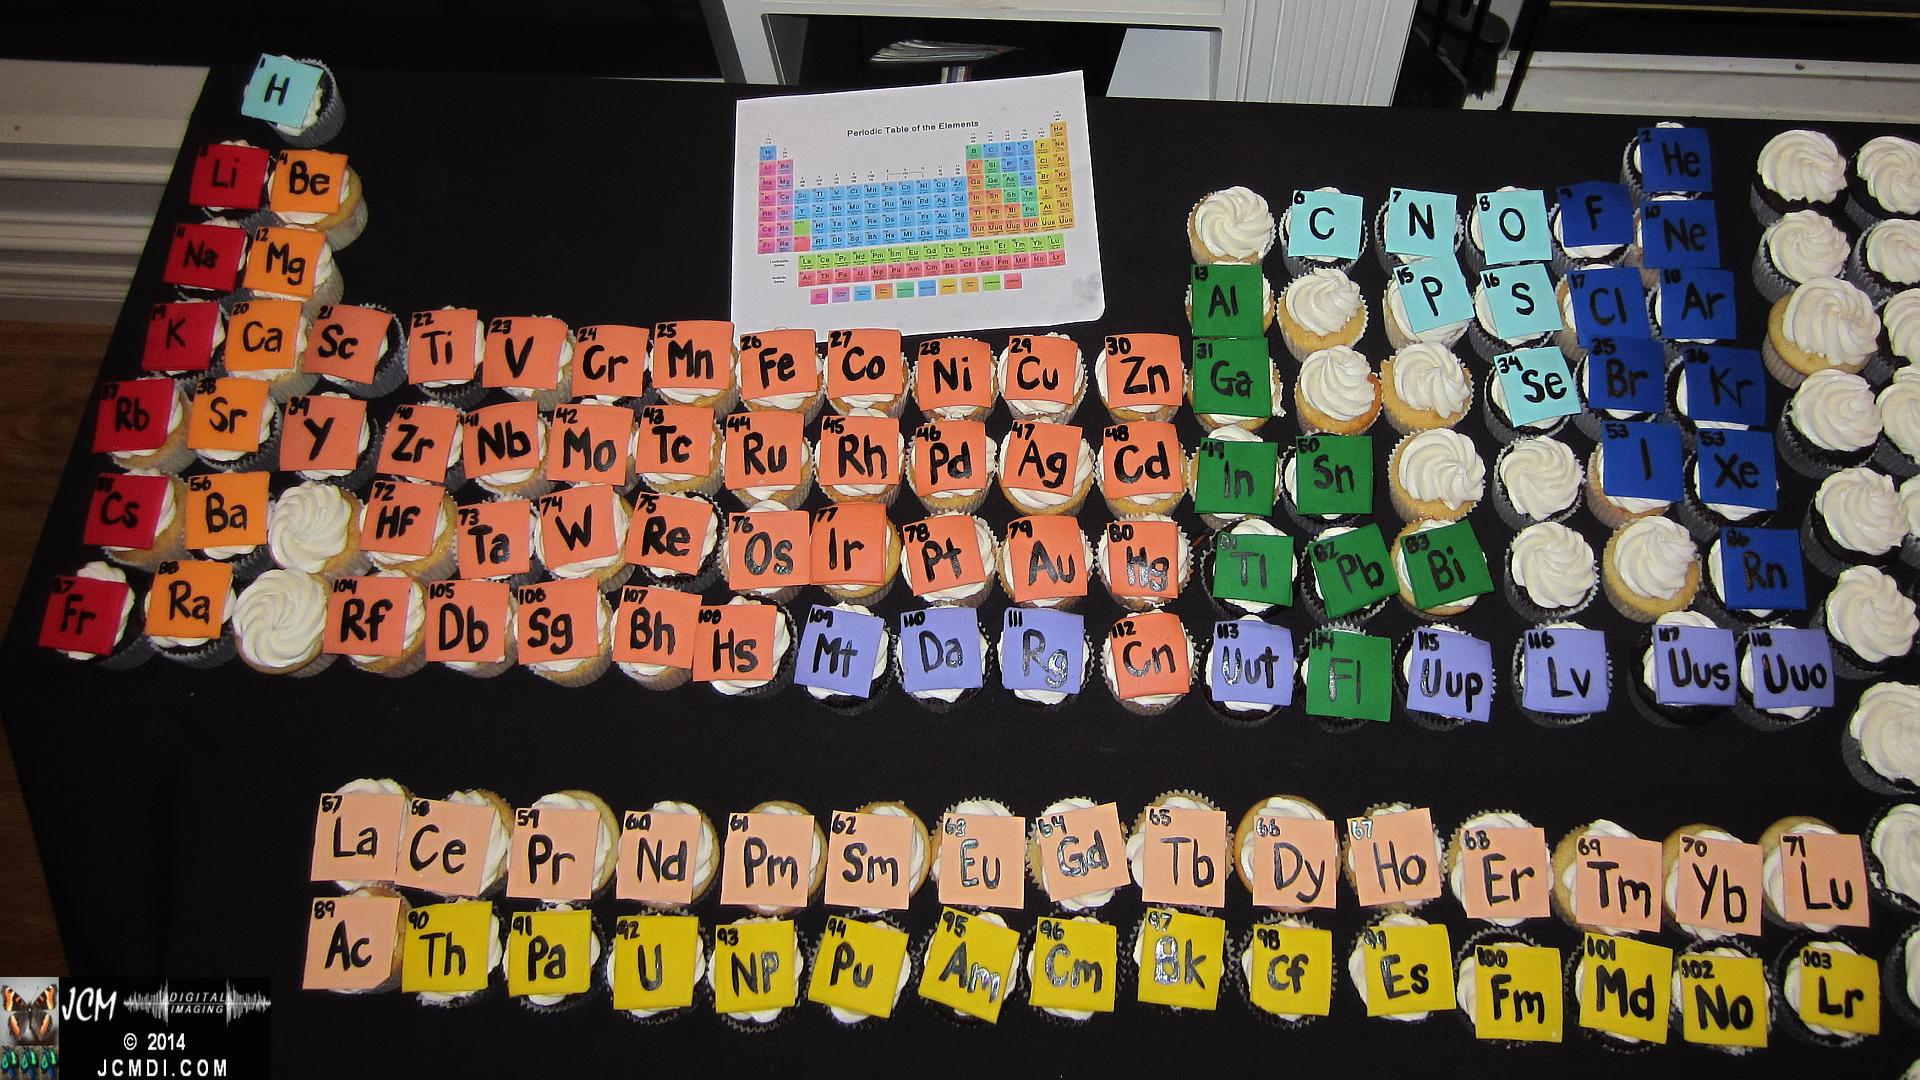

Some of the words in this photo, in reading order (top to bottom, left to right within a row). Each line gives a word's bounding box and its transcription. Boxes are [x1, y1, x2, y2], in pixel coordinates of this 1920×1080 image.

[264, 74, 291, 105] H
[847, 128, 882, 137] Periodic
[938, 121, 979, 130] Elements
[212, 158, 238, 189] Li
[289, 162, 330, 196] Be
[1662, 142, 1699, 176] He
[1392, 191, 1402, 202] 7
[1479, 195, 1490, 211] 8
[1585, 196, 1605, 230] F
[255, 227, 268, 242] 12
[1309, 207, 1334, 240] C
[1408, 202, 1434, 239] N
[1499, 208, 1525, 242] O
[1664, 219, 1707, 252] Ne
[184, 242, 218, 268] Na
[266, 242, 306, 284] Mg
[1421, 277, 1442, 316] P
[1484, 273, 1500, 287] 16
[1511, 283, 1534, 315] S
[412, 312, 434, 327] 22
[1208, 285, 1238, 318] Al
[1589, 288, 1627, 326] Cl
[1681, 282, 1725, 320] Ar
[166, 318, 186, 347] K
[243, 321, 282, 352] Ca
[318, 324, 358, 359] Sc
[421, 331, 452, 365] Ti
[657, 323, 676, 338] 25
[830, 331, 852, 347] 27
[1108, 338, 1132, 354] 30
[505, 336, 534, 378] V
[582, 345, 628, 382] Cr
[667, 339, 713, 379] Mn
[758, 348, 795, 389] Fe
[842, 347, 886, 381] Co
[933, 357, 971, 393] Ni
[1017, 356, 1059, 390] Cu
[1120, 356, 1170, 394] Zn
[1497, 354, 1523, 374] 34
[1210, 360, 1254, 398] Ga
[1521, 369, 1568, 403] Se
[1606, 358, 1648, 399] Br
[1709, 367, 1755, 408] Kr
[210, 401, 247, 433] Sr
[556, 408, 578, 423] 42
[1012, 421, 1035, 438] 47
[1606, 424, 1629, 439] 53
[304, 417, 334, 460] Y
[391, 424, 434, 463] Zr
[477, 421, 531, 464] Nb
[563, 427, 617, 471] Mo
[653, 425, 692, 463] Tc
[743, 432, 787, 474] Ru
[838, 434, 888, 479] Rh
[930, 442, 971, 485] Pd
[1018, 440, 1067, 488] Ag
[1113, 441, 1170, 483] Cd
[1224, 460, 1254, 498] In
[1313, 455, 1355, 494] Sn
[1715, 453, 1760, 490] Xe
[206, 492, 248, 533] Ba
[376, 506, 420, 538] Hf
[556, 505, 591, 550] W
[468, 525, 510, 564] Ta
[642, 516, 691, 557] Re
[744, 532, 793, 575] Os
[829, 528, 864, 571] Ir
[922, 537, 962, 582] Pt
[1028, 541, 1076, 585] Au
[1230, 552, 1268, 589] Tl
[1337, 555, 1384, 594] Pb
[1428, 545, 1466, 592] Bi
[1744, 551, 1788, 592] Rn
[169, 580, 211, 623] Ra
[332, 579, 358, 594] 104
[340, 598, 393, 642] Rf
[439, 603, 489, 653] Db
[528, 607, 573, 654] Sg
[630, 606, 675, 655] Bh
[1528, 630, 1554, 650] 116
[712, 629, 758, 672] Hs
[812, 633, 858, 678] Mt
[1022, 629, 1069, 689] Rg
[1123, 642, 1177, 677] Cn
[1222, 646, 1279, 689] Uut
[1668, 648, 1729, 691] Uus
[1329, 657, 1361, 704] Fl
[1422, 658, 1484, 713] Uup
[1547, 657, 1590, 697] Lv
[1763, 654, 1827, 694] Uuo
[321, 795, 342, 814] 57
[517, 809, 539, 828] 59
[332, 816, 378, 858] La
[833, 816, 856, 834] 62
[409, 824, 466, 875] Ce
[527, 834, 576, 885] Pr
[637, 837, 686, 883] Nd
[743, 837, 798, 890] Pm
[842, 842, 898, 886] Sm
[960, 838, 1000, 889] Eu
[1057, 830, 1109, 878] Gd
[1161, 837, 1215, 887] Tb
[1578, 837, 1601, 856] 69
[1682, 837, 1707, 857] 70
[1782, 836, 1806, 856] 71
[1273, 843, 1325, 902] Dy
[1373, 841, 1426, 893] Ho
[1483, 854, 1534, 906] Er
[1801, 862, 1853, 910] Lu
[1587, 862, 1651, 918] Tm
[1692, 863, 1746, 924] Yb
[407, 911, 429, 929] 90
[325, 920, 372, 971] Ac
[418, 932, 466, 978] Th
[528, 935, 567, 982] Pa
[830, 941, 873, 988] Pu
[1154, 936, 1206, 989] Bk
[638, 944, 663, 991] U
[939, 942, 1000, 1004] Am
[1044, 943, 1102, 993] Cm
[1268, 954, 1309, 993] Cf
[1381, 954, 1429, 999] Es
[1491, 974, 1545, 1023] Fm
[1596, 966, 1654, 1021] Md
[1695, 984, 1753, 1030] No
[1819, 976, 1863, 1018] Lr
